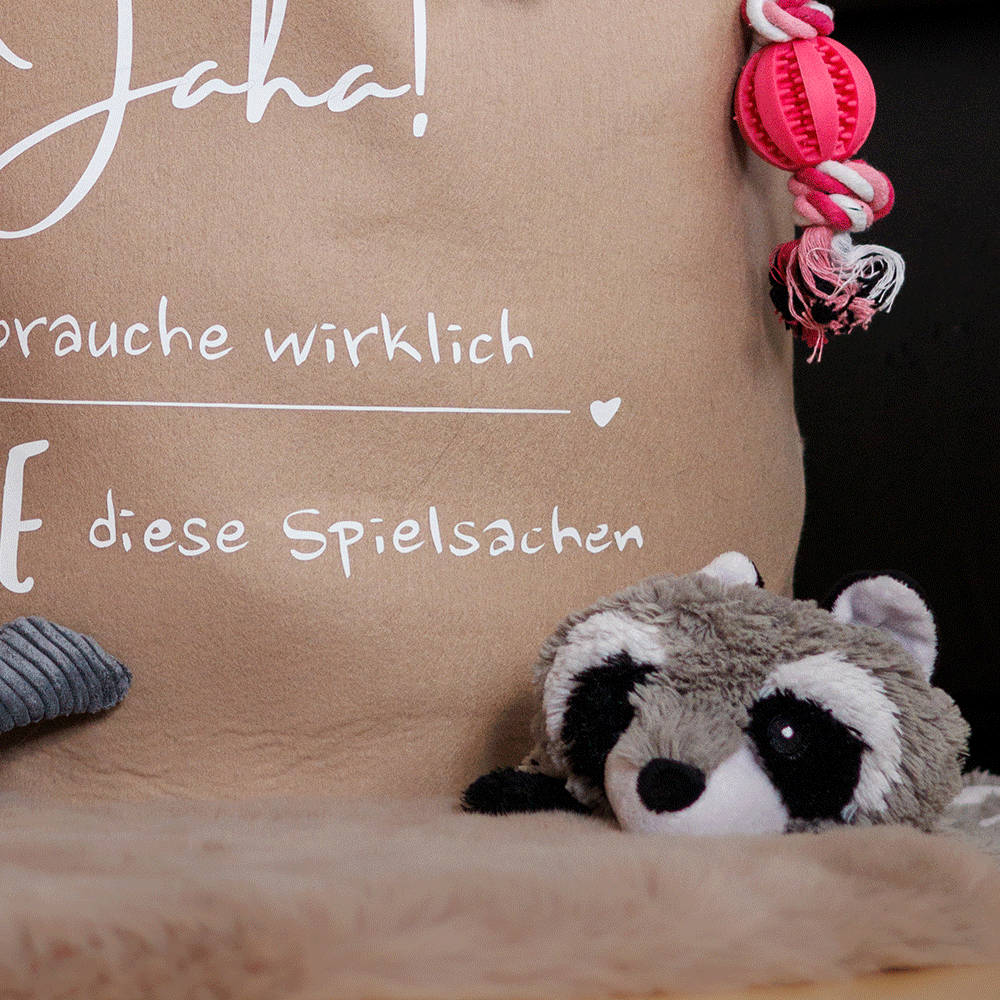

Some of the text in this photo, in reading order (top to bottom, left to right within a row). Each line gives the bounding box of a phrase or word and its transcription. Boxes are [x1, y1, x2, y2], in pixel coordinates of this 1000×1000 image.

[264, 308, 534, 368] wirklich
[89, 489, 249, 556] diese
[283, 505, 643, 578] Spielsachen
